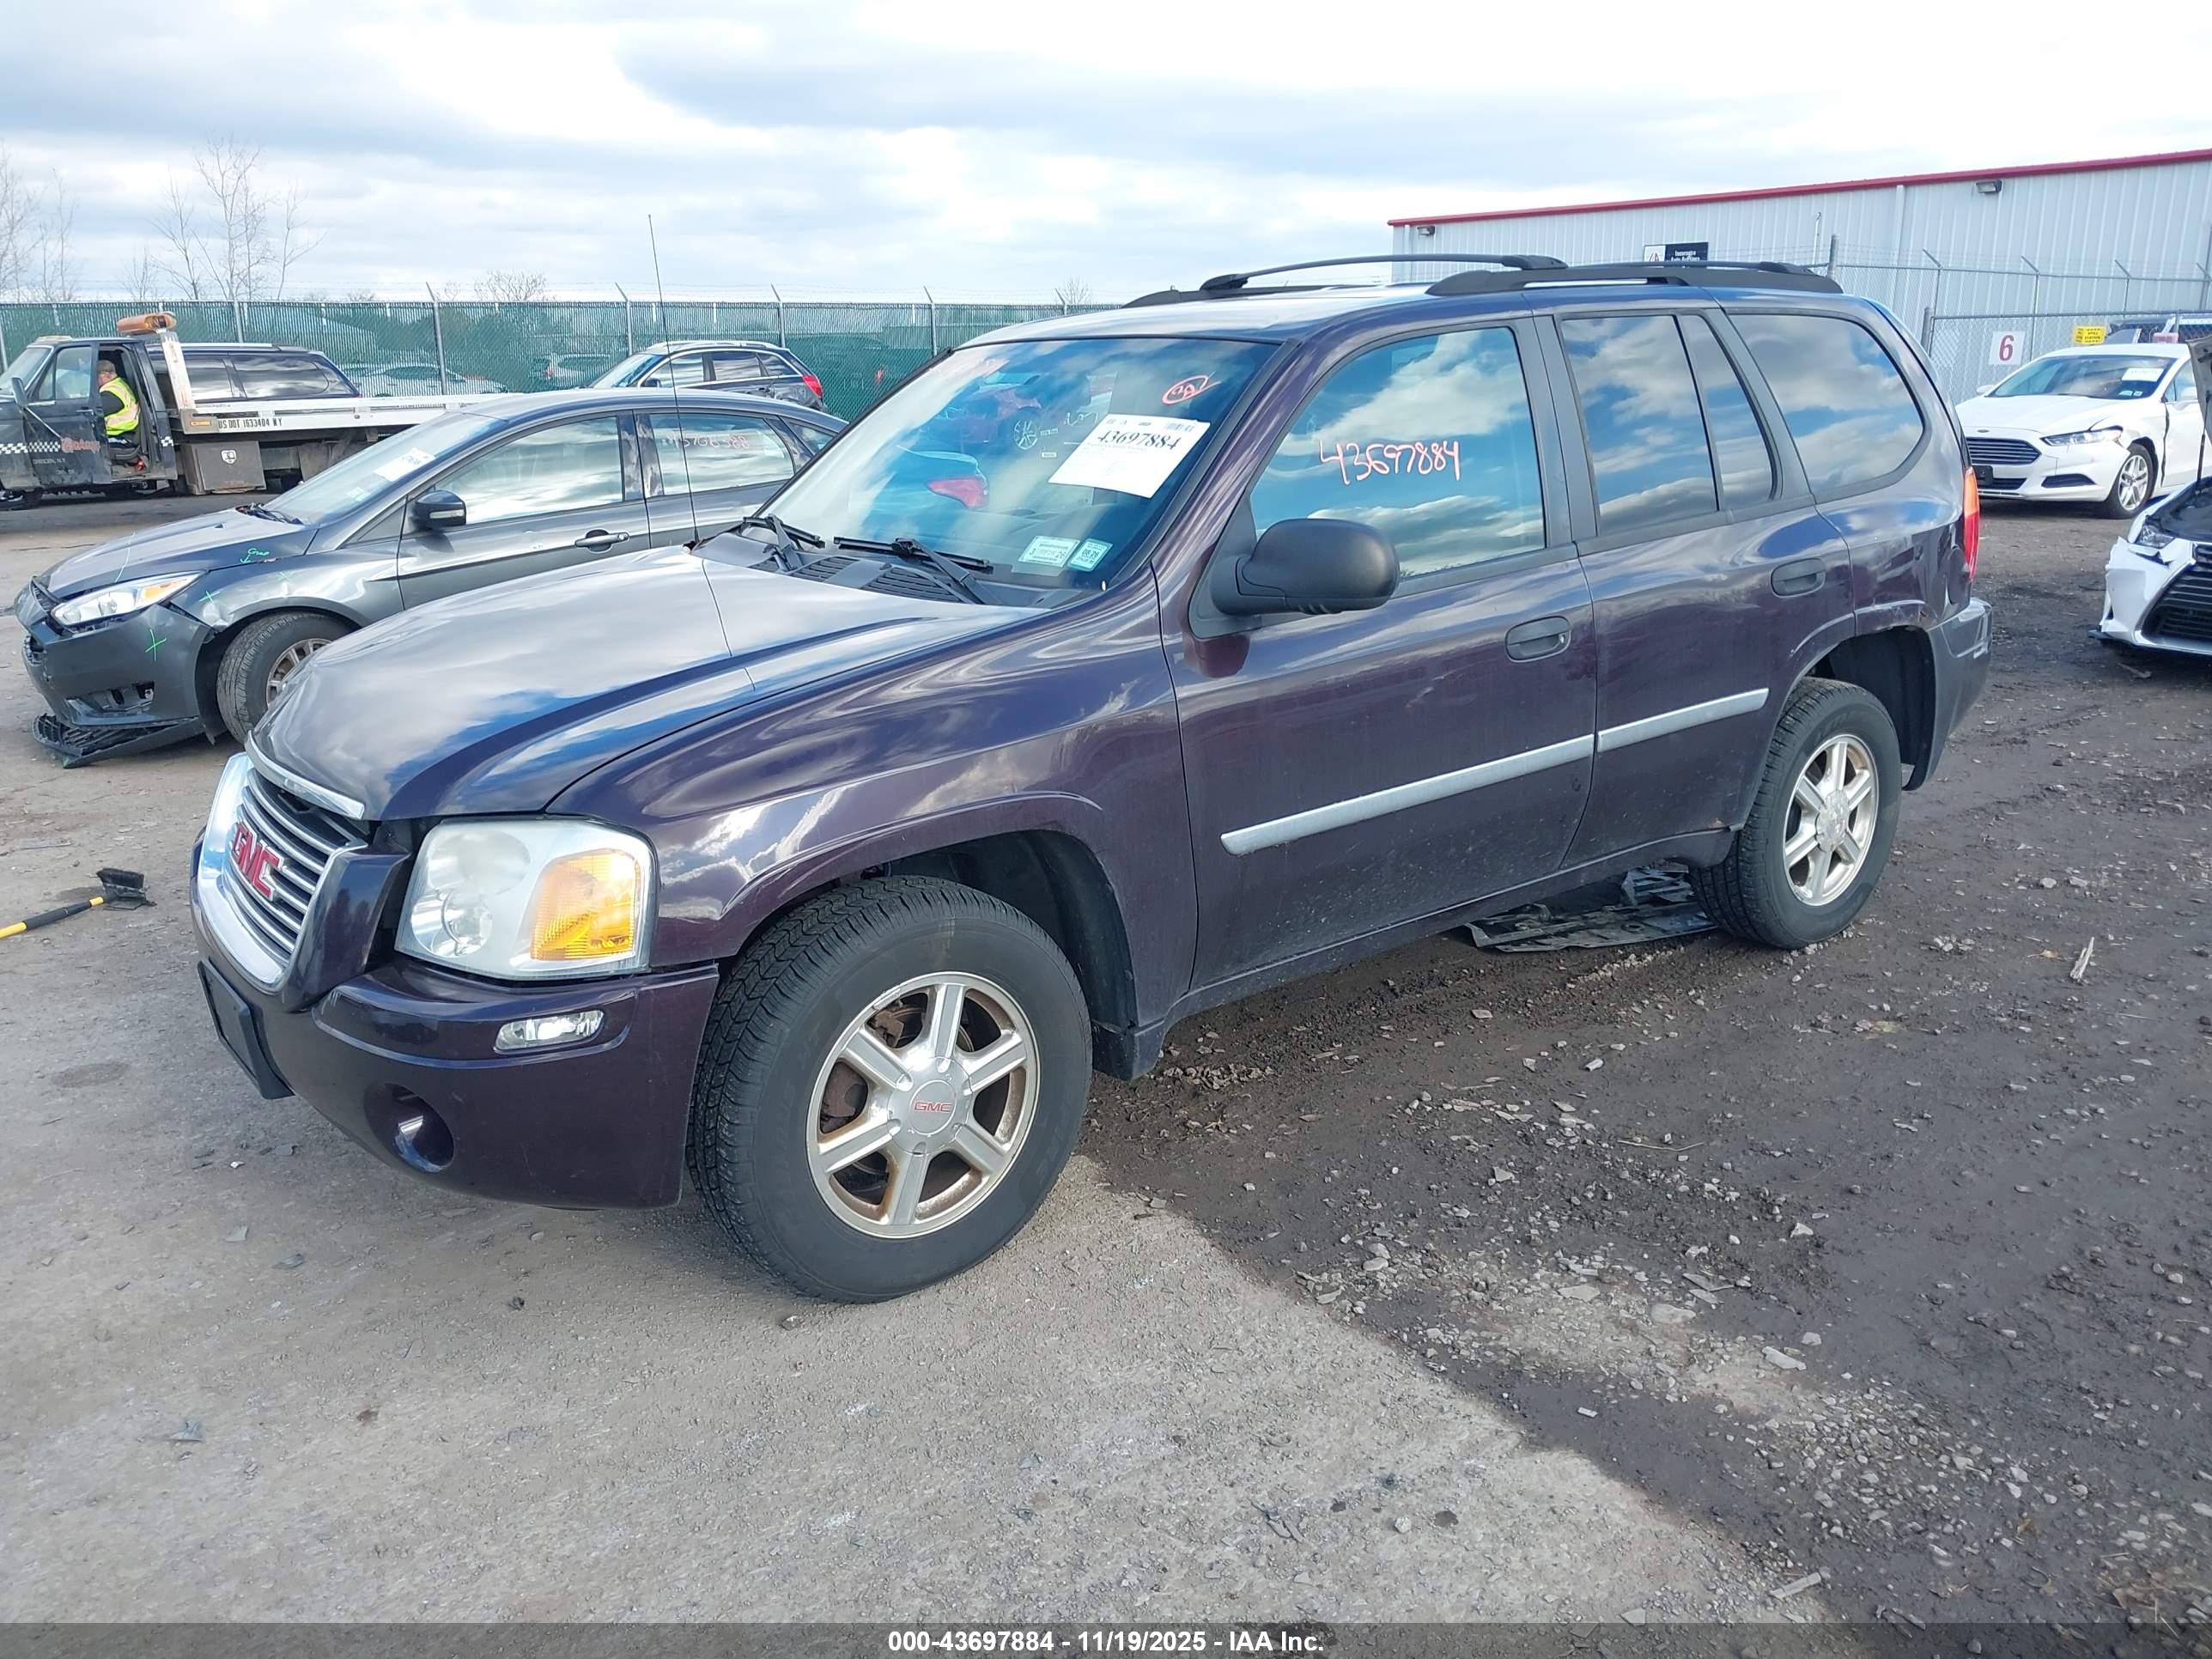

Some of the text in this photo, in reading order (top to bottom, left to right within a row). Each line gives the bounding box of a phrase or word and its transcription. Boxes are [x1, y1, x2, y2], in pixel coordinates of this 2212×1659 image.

[1999, 334, 2014, 362] 6
[1098, 430, 1182, 450] 43697884
[1319, 439, 1460, 485] 43697884
[229, 819, 283, 901] GMC
[915, 1102, 953, 1113] GMC
